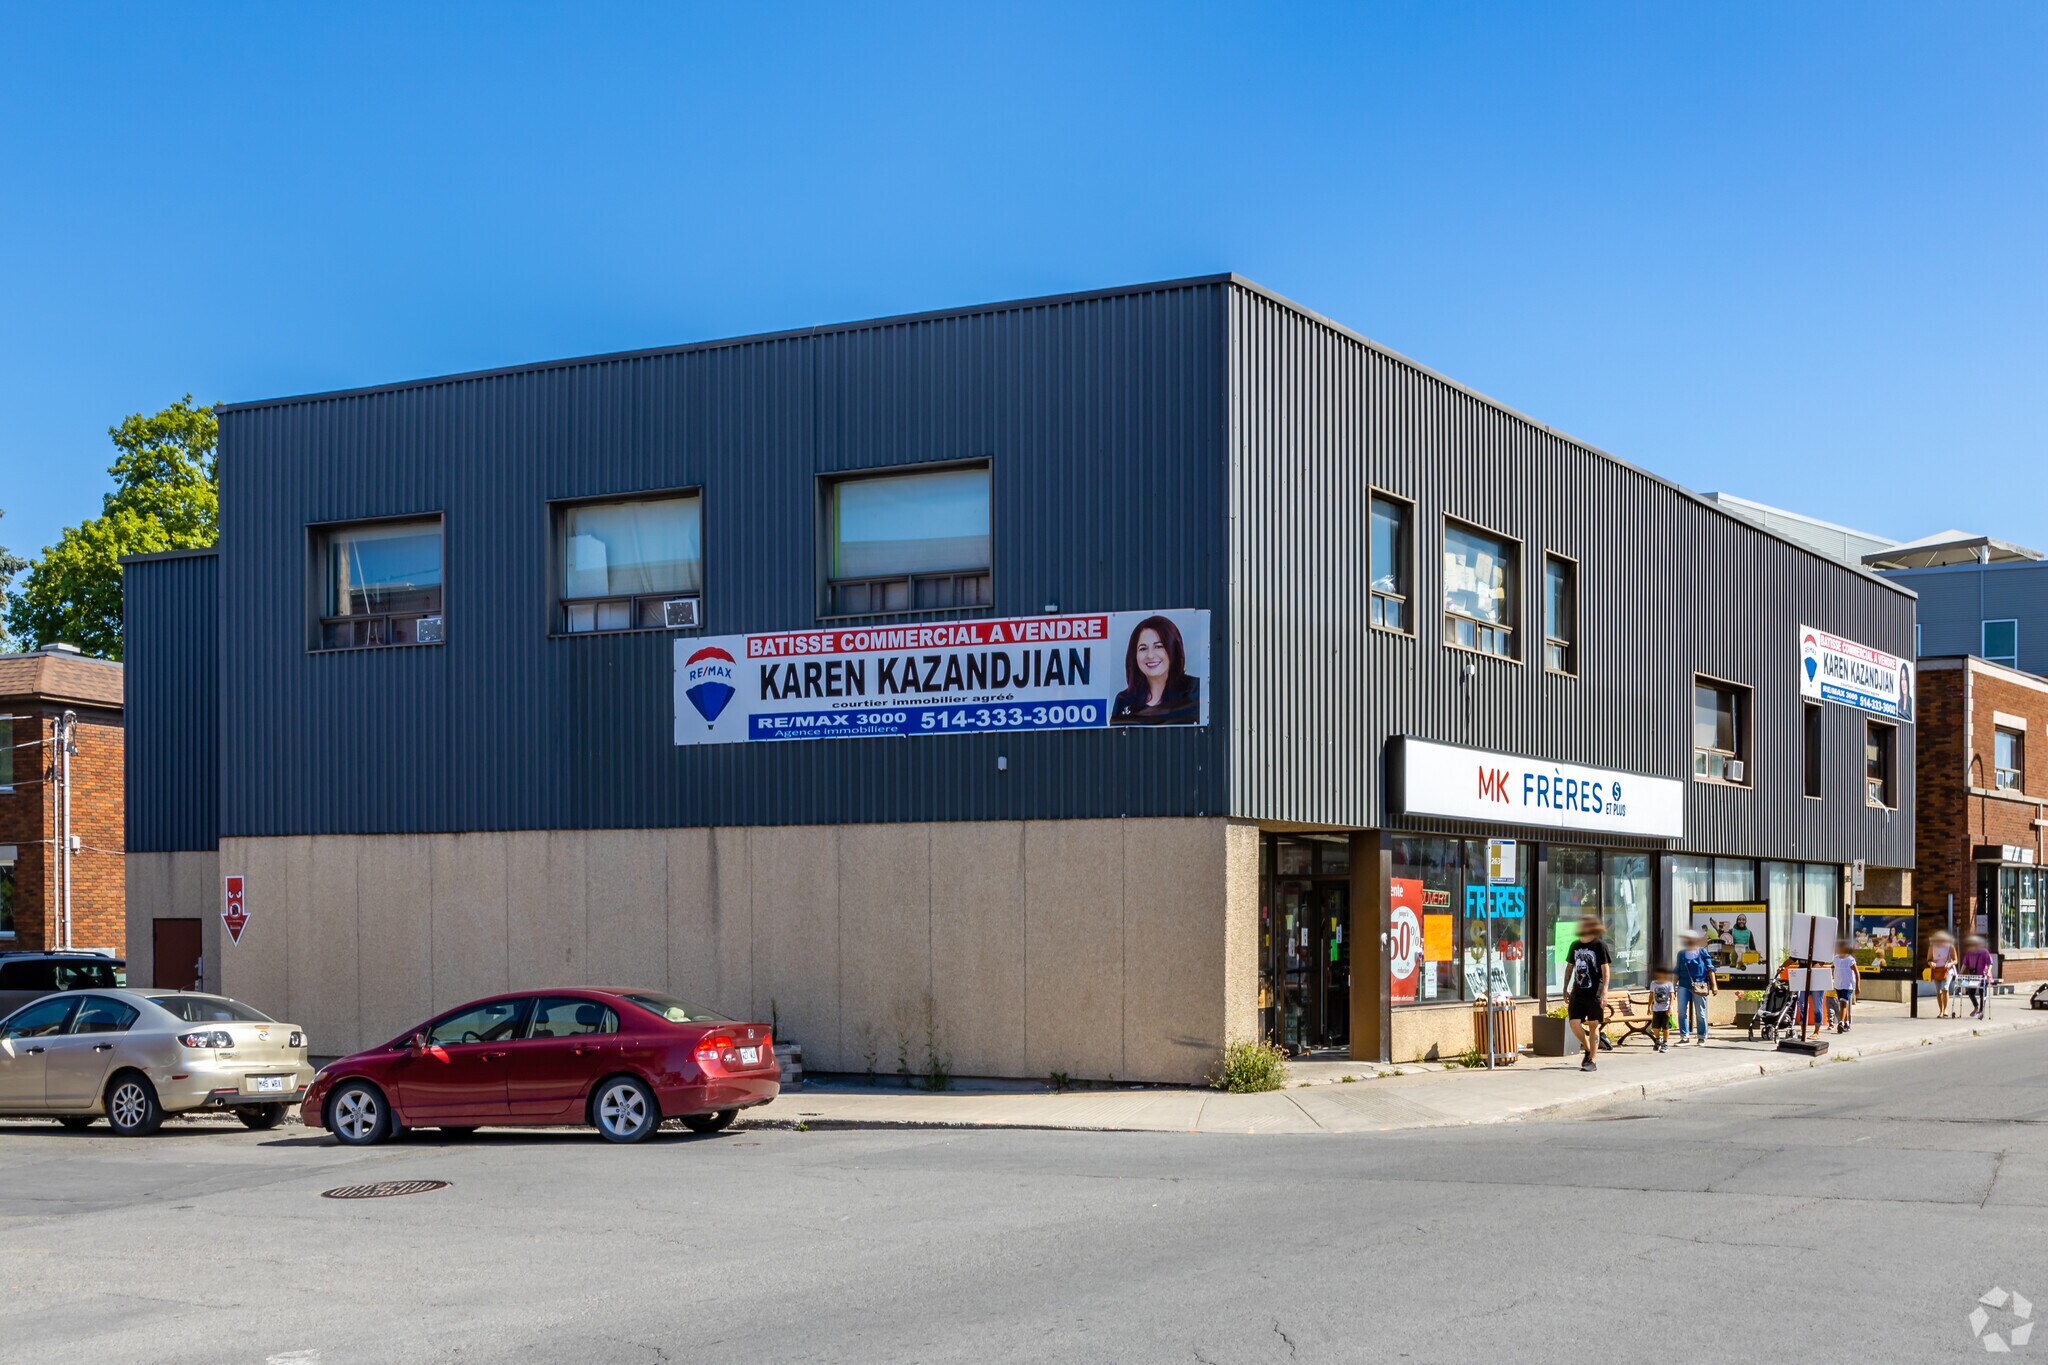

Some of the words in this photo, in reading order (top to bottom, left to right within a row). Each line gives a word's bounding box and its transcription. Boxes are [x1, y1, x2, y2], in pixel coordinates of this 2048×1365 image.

[750, 635, 834, 657] BATISSE
[840, 627, 983, 651] COMMERCIAL
[989, 625, 1005, 642] A
[1010, 619, 1102, 641] VENDRE
[1821, 635, 1842, 652] BATISSE
[1842, 643, 1873, 660] COMMERCIAL
[1878, 654, 1896, 669] VENDRE
[689, 665, 732, 681] RE/MAX
[760, 658, 865, 701] KAREN
[877, 647, 1091, 695] KAZANDJIAN
[1823, 652, 1849, 680] KAREN
[1850, 660, 1894, 694] KAZANDJIAN
[832, 699, 889, 709] courtier
[892, 695, 968, 706] immobilier
[972, 692, 1014, 704] agréé
[758, 715, 849, 729] RE/MAX
[856, 712, 907, 725] 3000
[921, 704, 1097, 729] 514-333-3000
[774, 727, 821, 738] Agence
[1478, 765, 1510, 804] MK
[1523, 768, 1603, 814] FRÈRES
[1606, 803, 1612, 815] ET
[1613, 804, 1626, 817] PLUS
[1466, 882, 1525, 918] FRÈRES
[1499, 940, 1524, 961] PLUS
